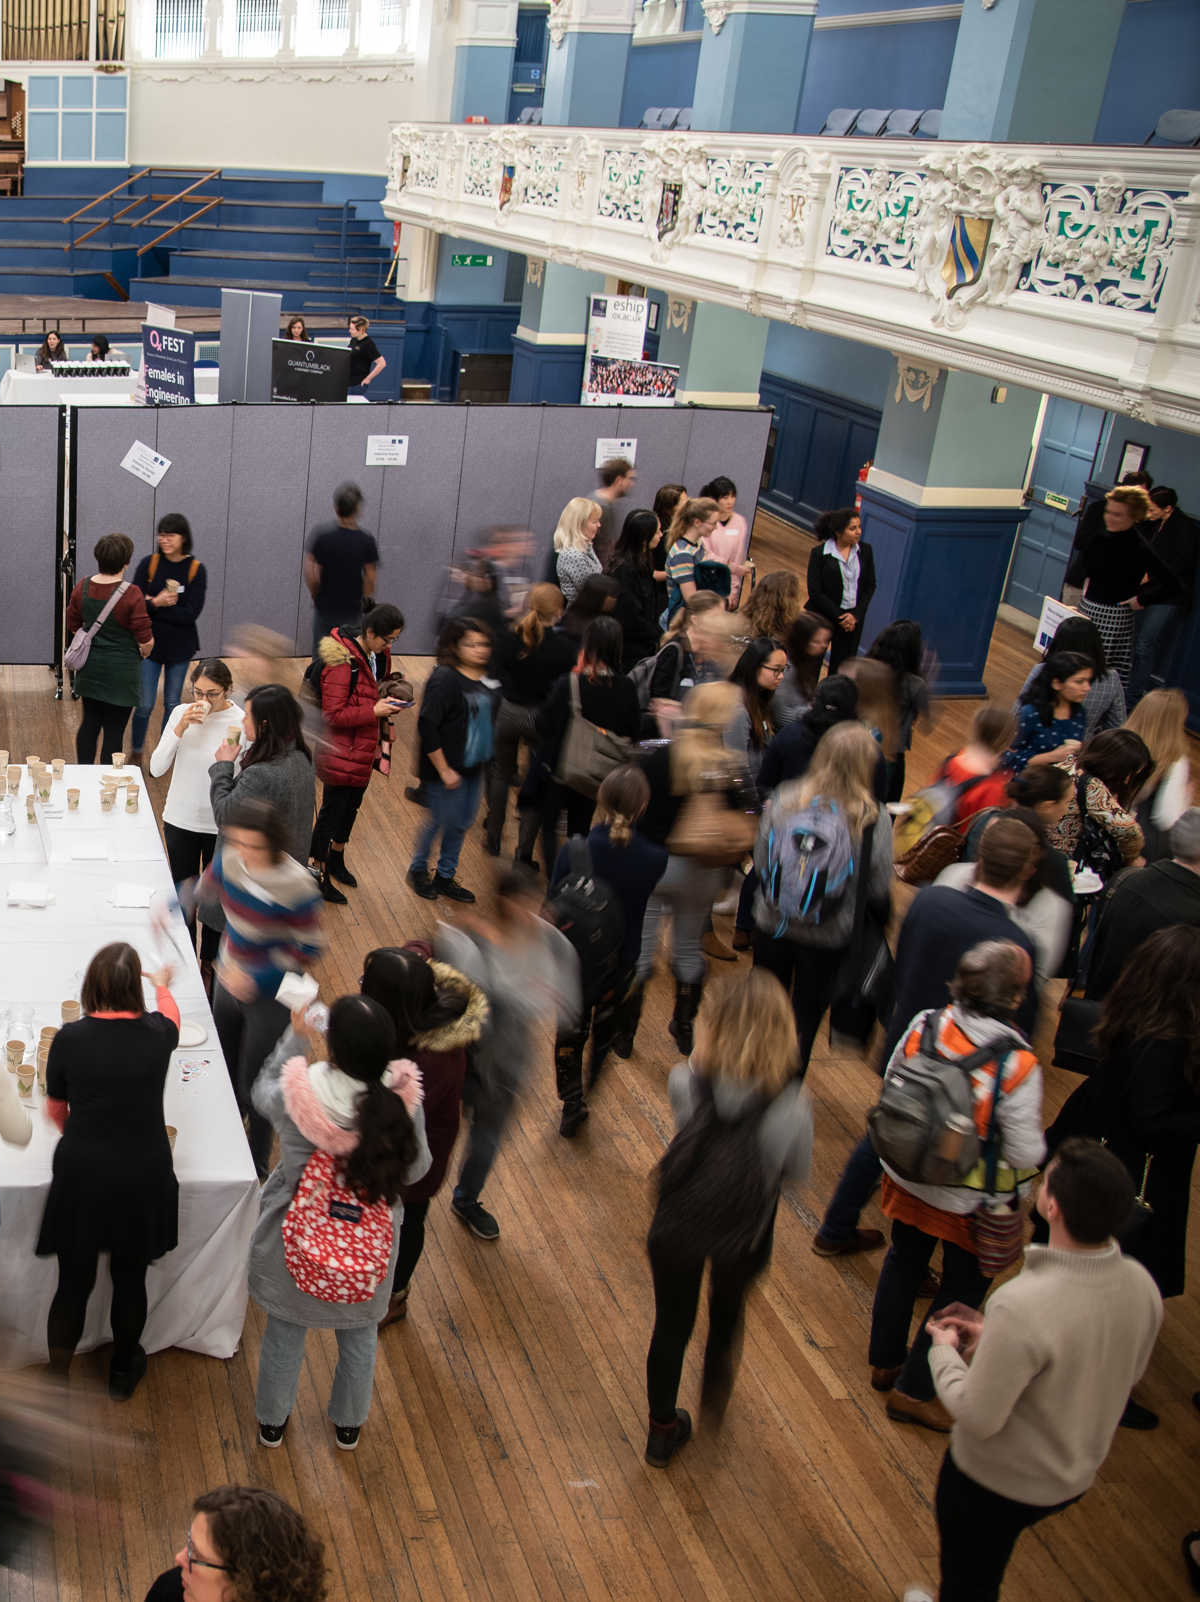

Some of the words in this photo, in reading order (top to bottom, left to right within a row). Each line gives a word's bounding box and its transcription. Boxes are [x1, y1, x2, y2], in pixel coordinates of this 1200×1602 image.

[613, 298, 644, 313] eship
[287, 360, 331, 371] QUANTUMBLACK
[144, 364, 177, 384] Females
[177, 371, 185, 386] in
